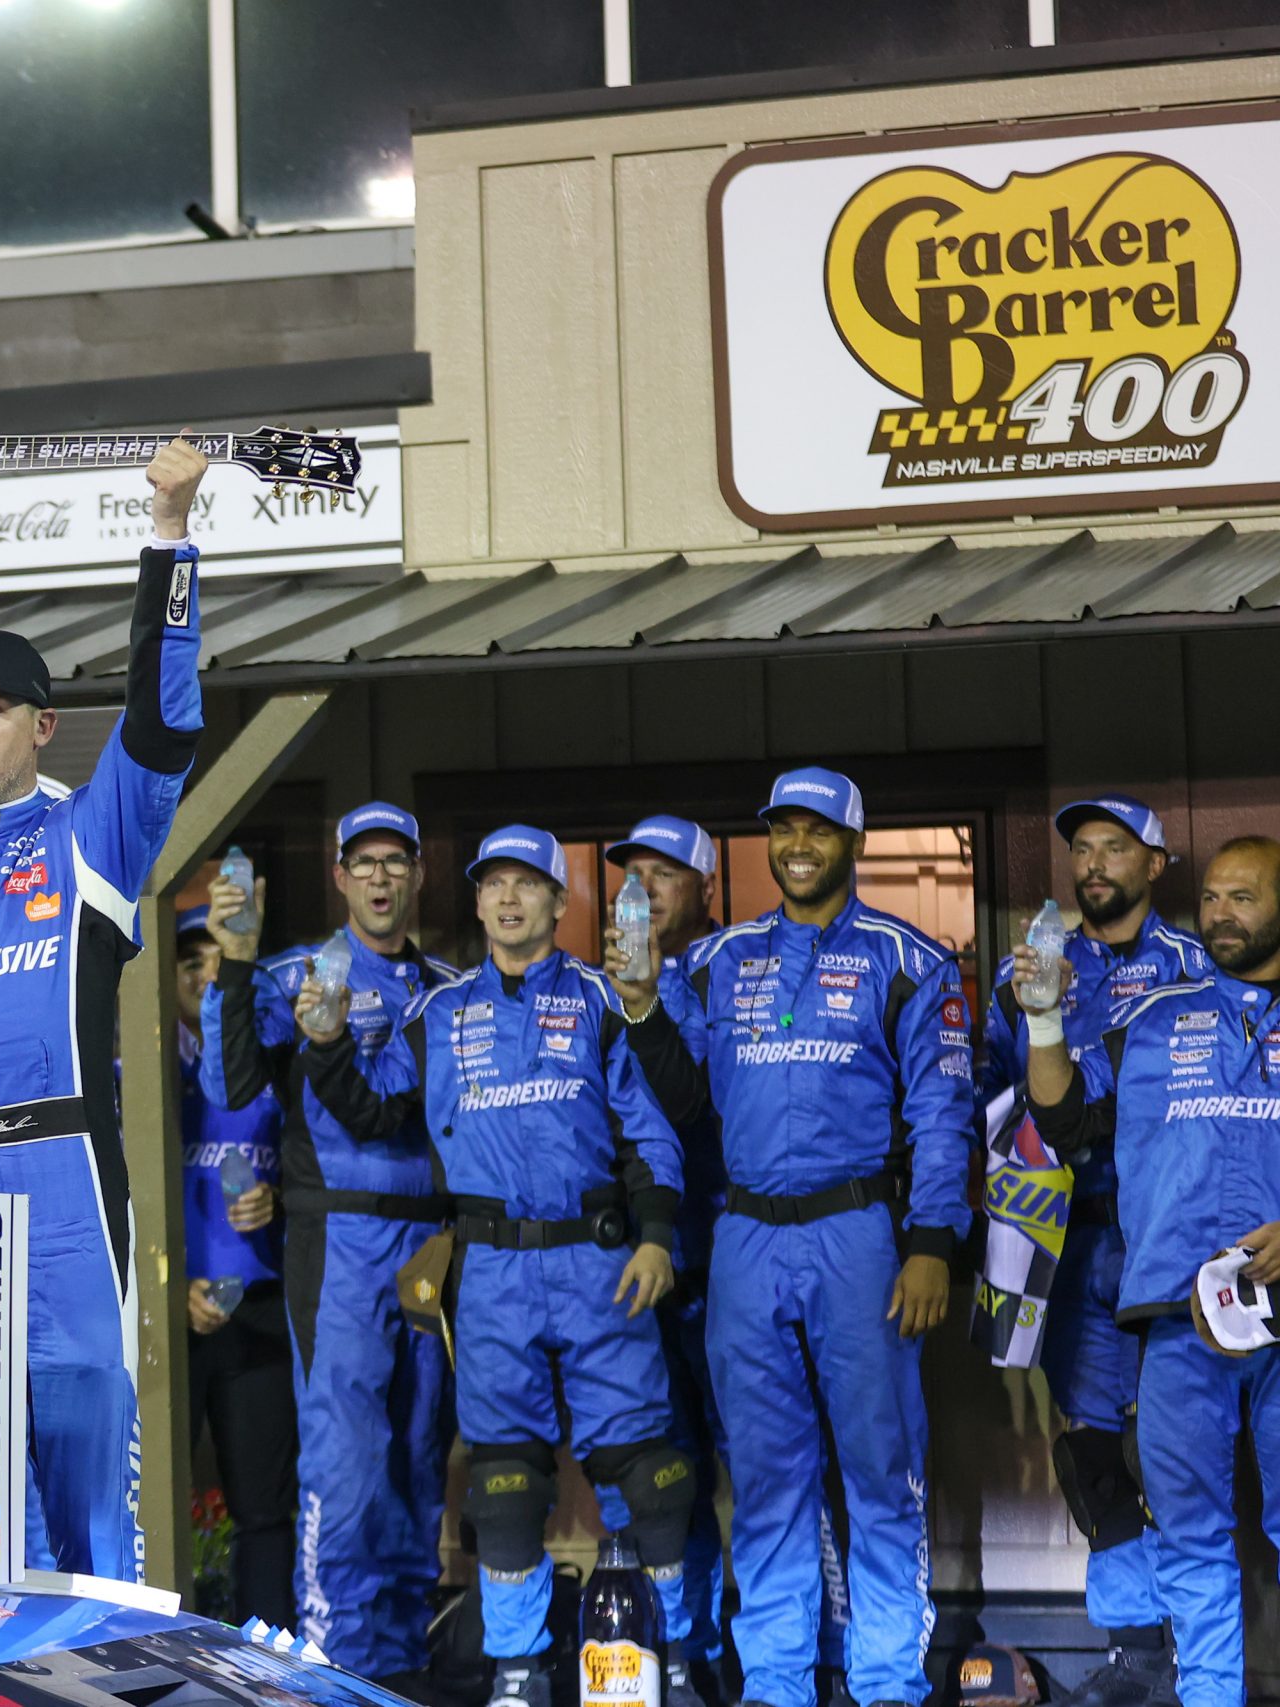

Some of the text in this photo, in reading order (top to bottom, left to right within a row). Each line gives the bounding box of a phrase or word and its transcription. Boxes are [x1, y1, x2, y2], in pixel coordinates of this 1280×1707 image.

[853, 194, 1190, 339] Cracker
[916, 261, 1200, 405] Barrel
[1010, 352, 1243, 444] 400
[896, 442, 1207, 480] NASHVILLE SUPERSPEEDWAY
[818, 953, 871, 970] TOYOTA
[535, 994, 587, 1010] TOYOTA
[736, 1038, 861, 1066] PROGRESSIVE
[458, 1078, 587, 1114] PROGRESSIVE
